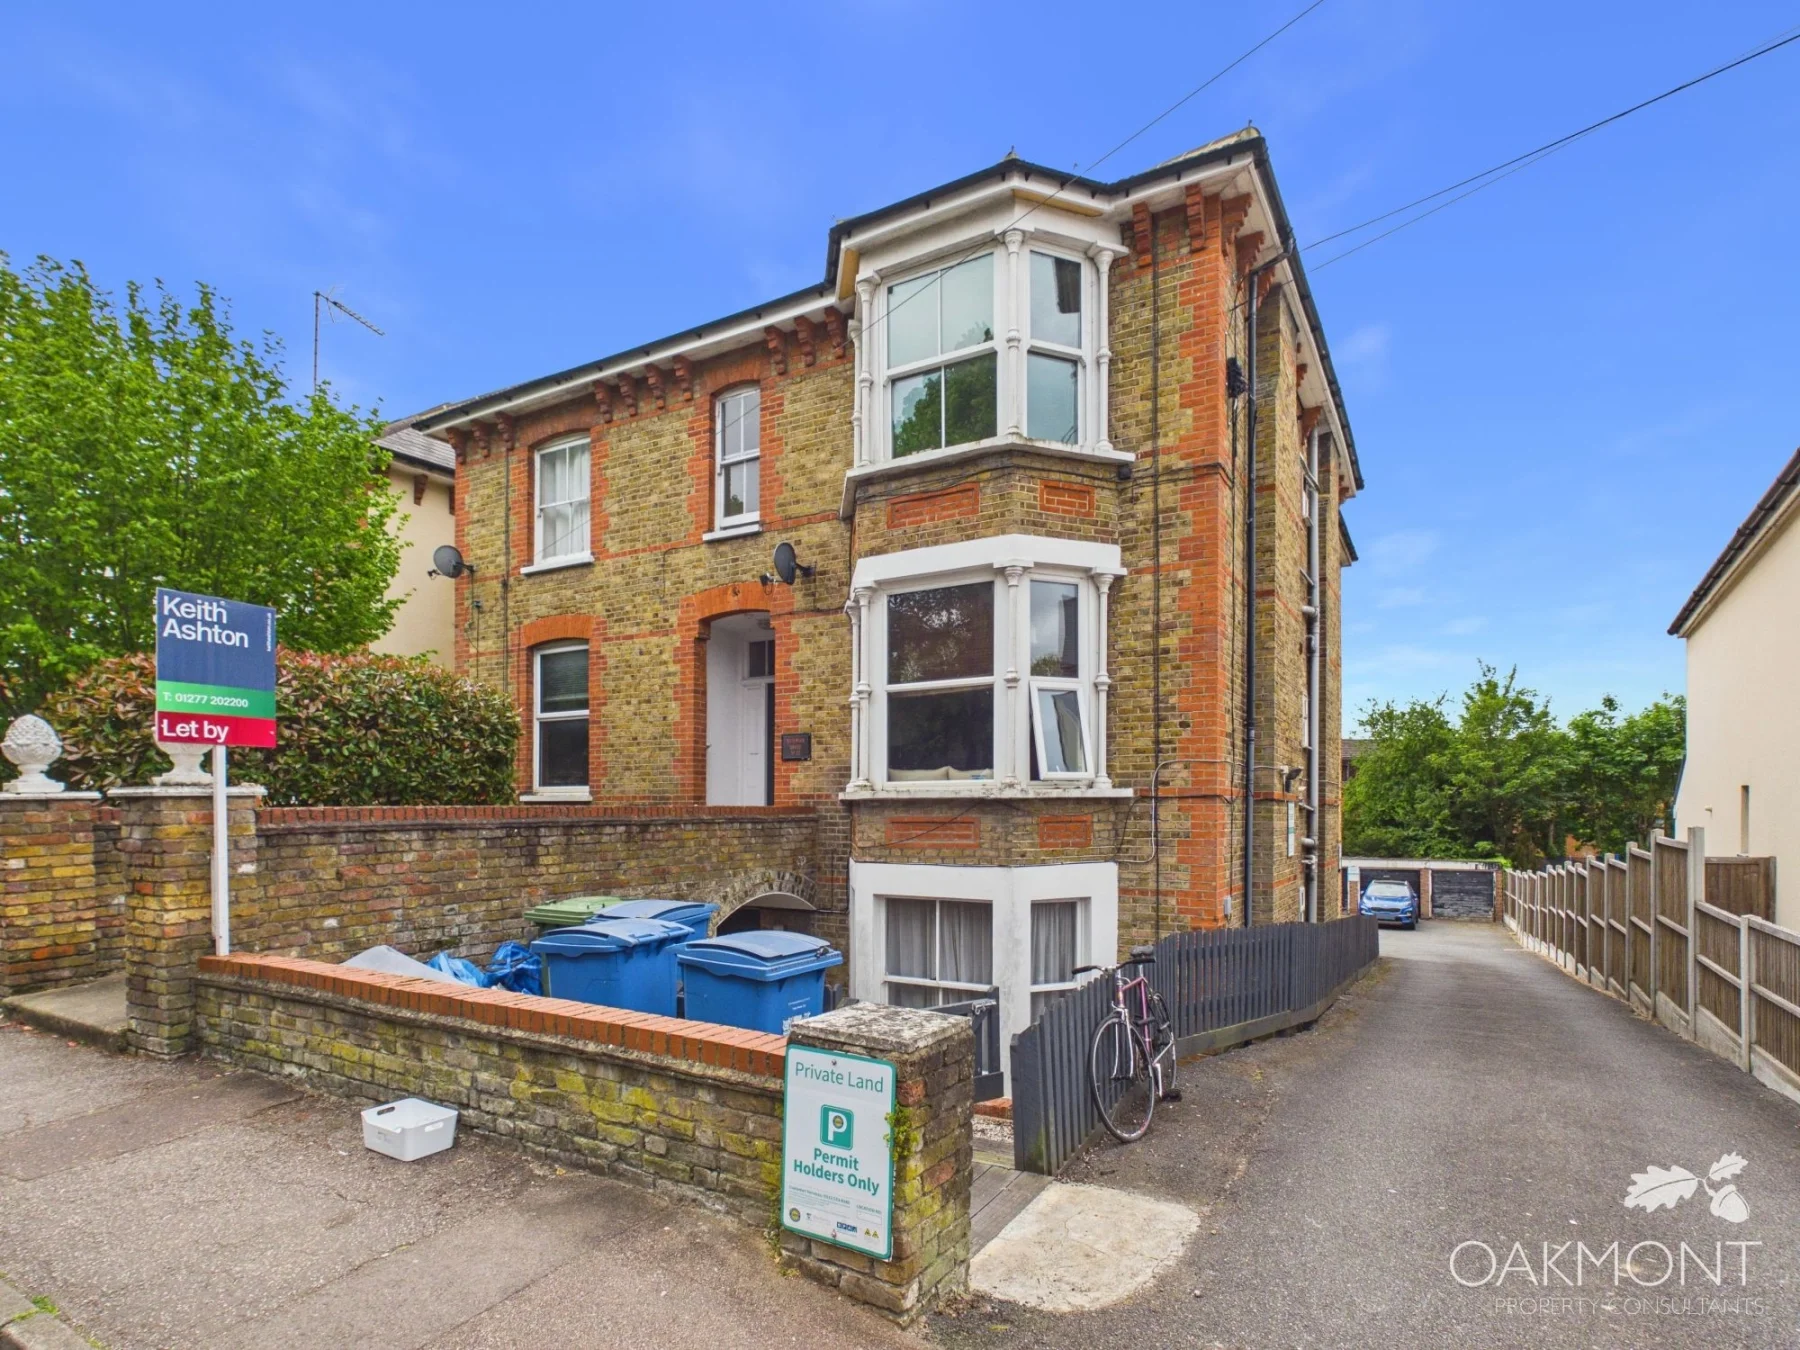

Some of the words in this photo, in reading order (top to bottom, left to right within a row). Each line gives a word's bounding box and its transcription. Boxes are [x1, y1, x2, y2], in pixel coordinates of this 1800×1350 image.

[163, 595, 227, 624] Keith
[163, 618, 248, 648] Ashton
[175, 693, 207, 704] 01277
[210, 695, 249, 708] 202200
[161, 718, 199, 738] Let
[203, 720, 229, 743] by
[795, 1061, 844, 1086] Private
[848, 1071, 884, 1093] Land
[813, 1147, 859, 1171] Permit
[793, 1159, 844, 1184] Holders
[847, 1173, 880, 1196] Only
